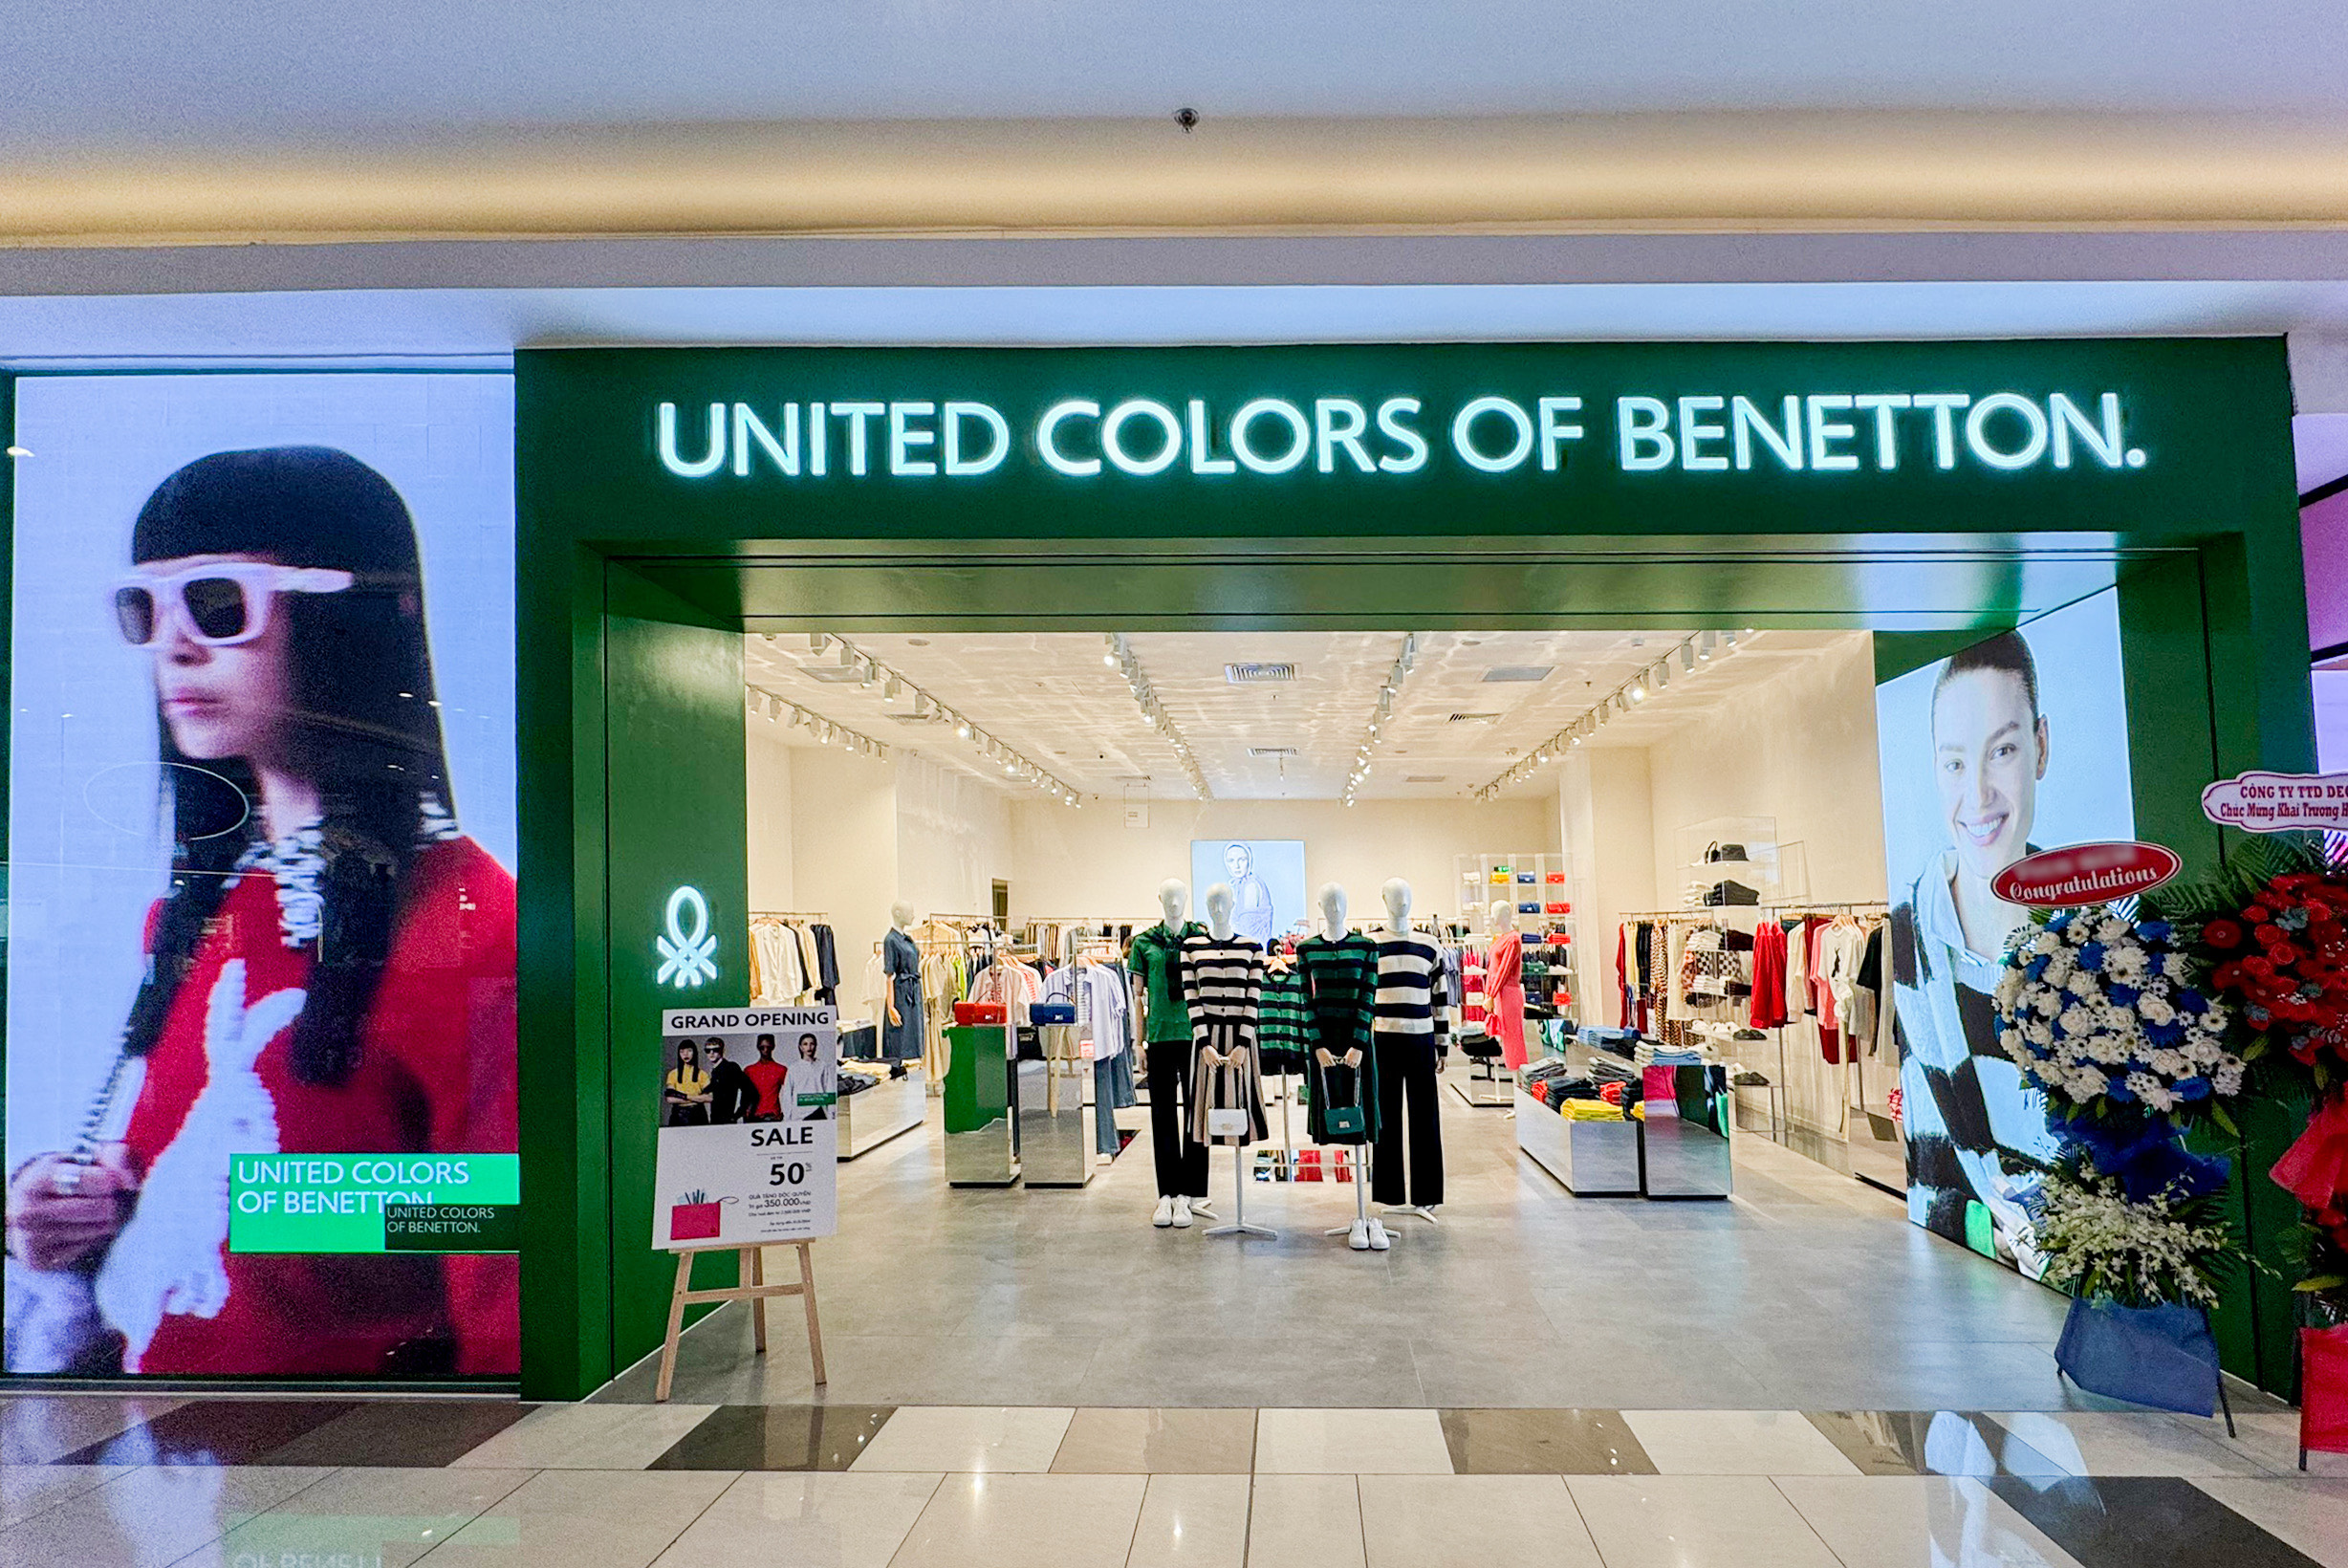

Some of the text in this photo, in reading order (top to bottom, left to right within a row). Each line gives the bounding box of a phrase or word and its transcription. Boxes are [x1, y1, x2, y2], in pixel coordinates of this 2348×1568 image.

[658, 392, 2146, 478] UNITED COLORS OF BENETTON.
[2278, 786, 2294, 798] TY
[2297, 785, 2322, 798] TTD
[2277, 803, 2299, 817] Khai
[2010, 867, 2160, 902] Congratulations
[671, 1012, 829, 1029] GRAND OPENING
[750, 1127, 814, 1147] SALE
[238, 1161, 469, 1185] UNITED COLORS
[770, 1162, 805, 1187] 50
[237, 1191, 277, 1214] OF
[387, 1207, 495, 1219] UNITED COLORS
[386, 1221, 481, 1233] OF BENETTON.
